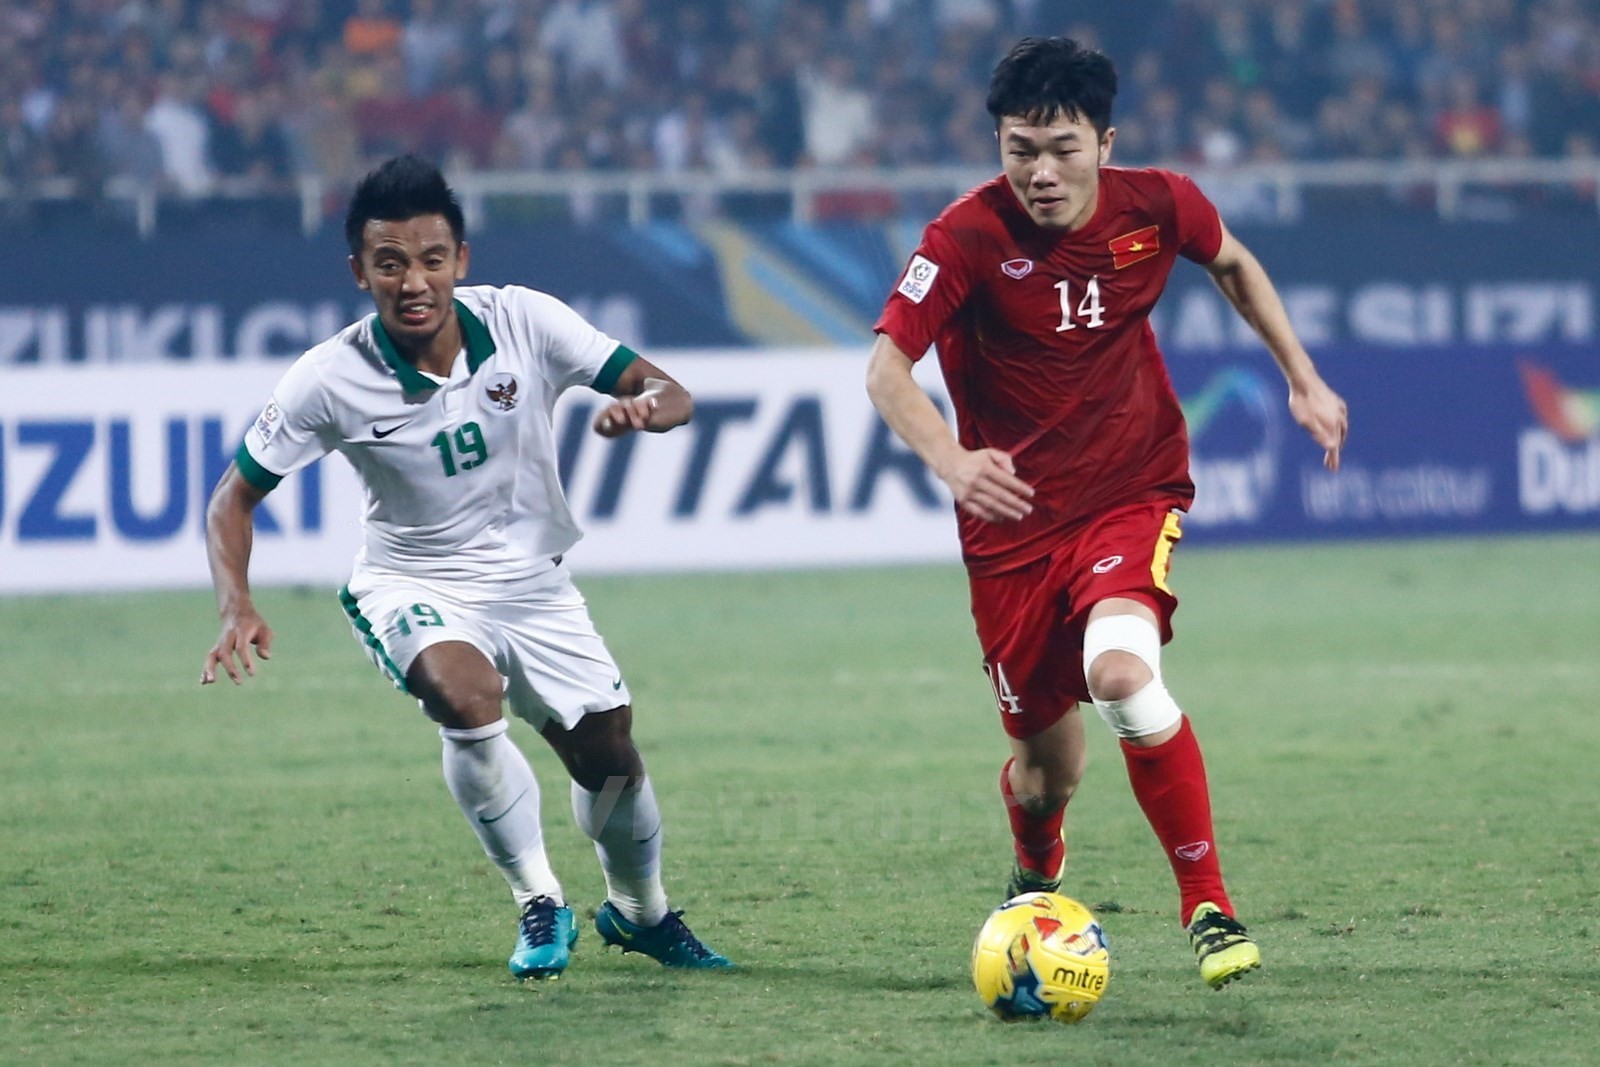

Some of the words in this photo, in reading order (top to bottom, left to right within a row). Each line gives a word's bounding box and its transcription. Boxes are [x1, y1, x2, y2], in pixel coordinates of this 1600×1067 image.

[1053, 274, 1106, 332] 14
[430, 421, 488, 477] 19
[396, 603, 446, 636] 19
[1053, 966, 1104, 991] mitre
